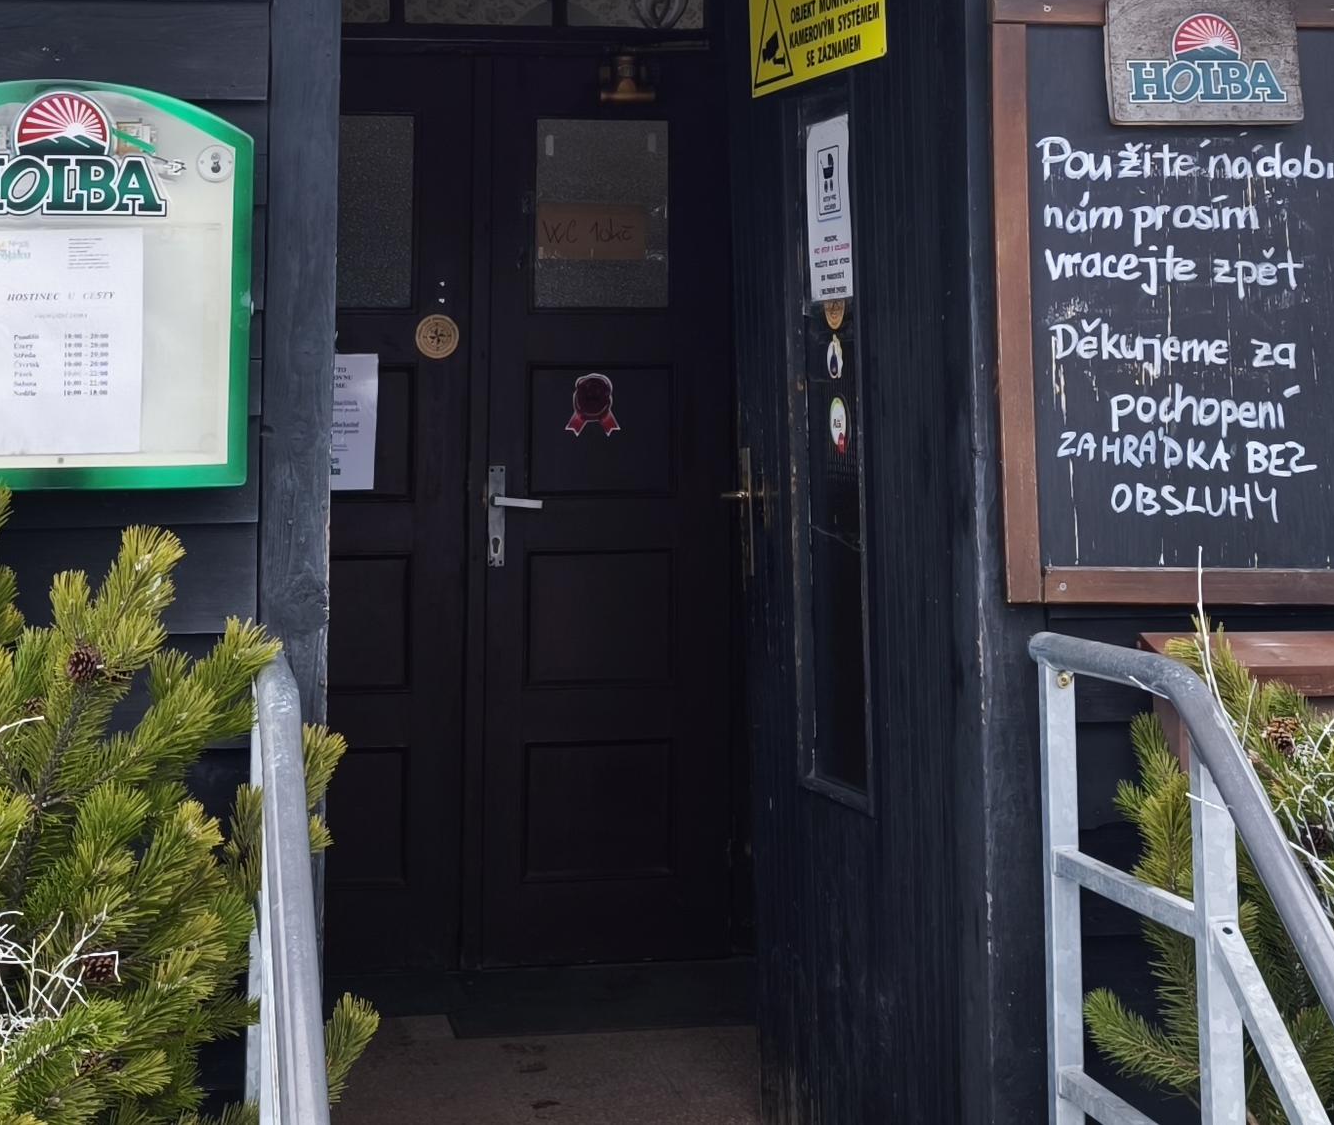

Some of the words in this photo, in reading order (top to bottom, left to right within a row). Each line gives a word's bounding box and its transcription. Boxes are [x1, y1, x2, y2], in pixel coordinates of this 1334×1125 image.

[789, 17, 835, 50] KAMEROVÝM
[838, 1, 880, 33] SYSTÉMEM
[790, 0, 816, 25] OBJEKT
[806, 50, 816, 68] SE
[818, 34, 862, 64] ZÁZNAMEM
[1125, 59, 1288, 104] HOLBA
[1035, 135, 1212, 181] Použité
[542, 218, 579, 244] WC
[1043, 190, 1123, 234] nám
[1129, 194, 1260, 248] prosím
[1044, 244, 1199, 297] vracejte
[1212, 246, 1305, 300] zpět
[7, 291, 61, 302] HOSTINEC
[1048, 316, 1230, 378] Děkujeme
[1250, 337, 1298, 370] za
[1109, 382, 1302, 439] pochopení
[1056, 426, 1232, 473] ZAHRÁDKA
[1245, 439, 1318, 478] BEZ
[1110, 480, 1280, 524] OBSLUHY
